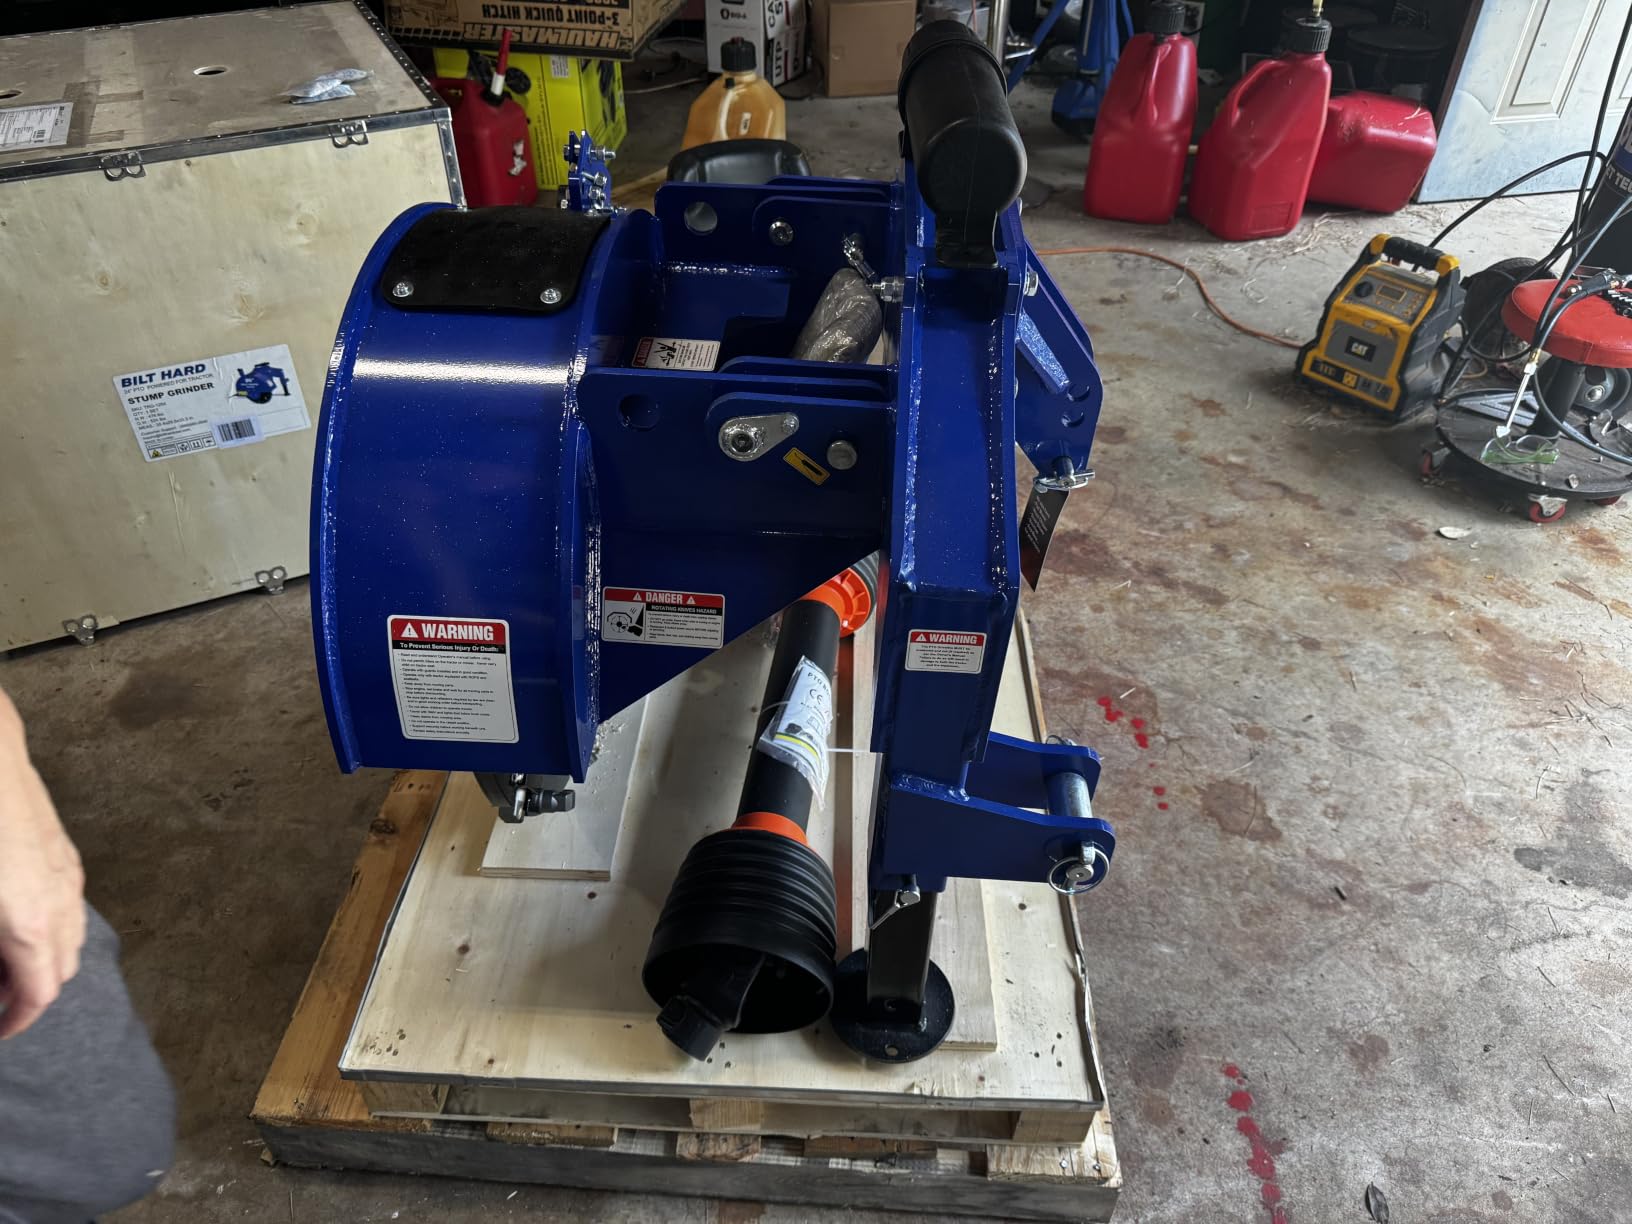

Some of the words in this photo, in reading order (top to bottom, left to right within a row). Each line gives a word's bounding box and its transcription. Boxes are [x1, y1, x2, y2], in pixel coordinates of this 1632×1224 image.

[482, 4, 521, 20] HITCH
[525, 5, 564, 23] QUICK
[566, 9, 620, 26] 3-POINT
[463, 23, 619, 50] HAULMASTER
[775, 41, 783, 78] UTP
[1351, 342, 1368, 356] CAT
[121, 373, 156, 388] BILT
[161, 363, 206, 380] HARD
[147, 380, 175, 390] POWERED
[188, 373, 214, 382] TRACTOR
[127, 391, 165, 405] STUMP
[167, 382, 215, 397] GRINDER
[646, 592, 683, 605] DANGER
[651, 604, 677, 612] ROTATING
[421, 622, 494, 641] WARNING
[929, 633, 978, 644] WARNING
